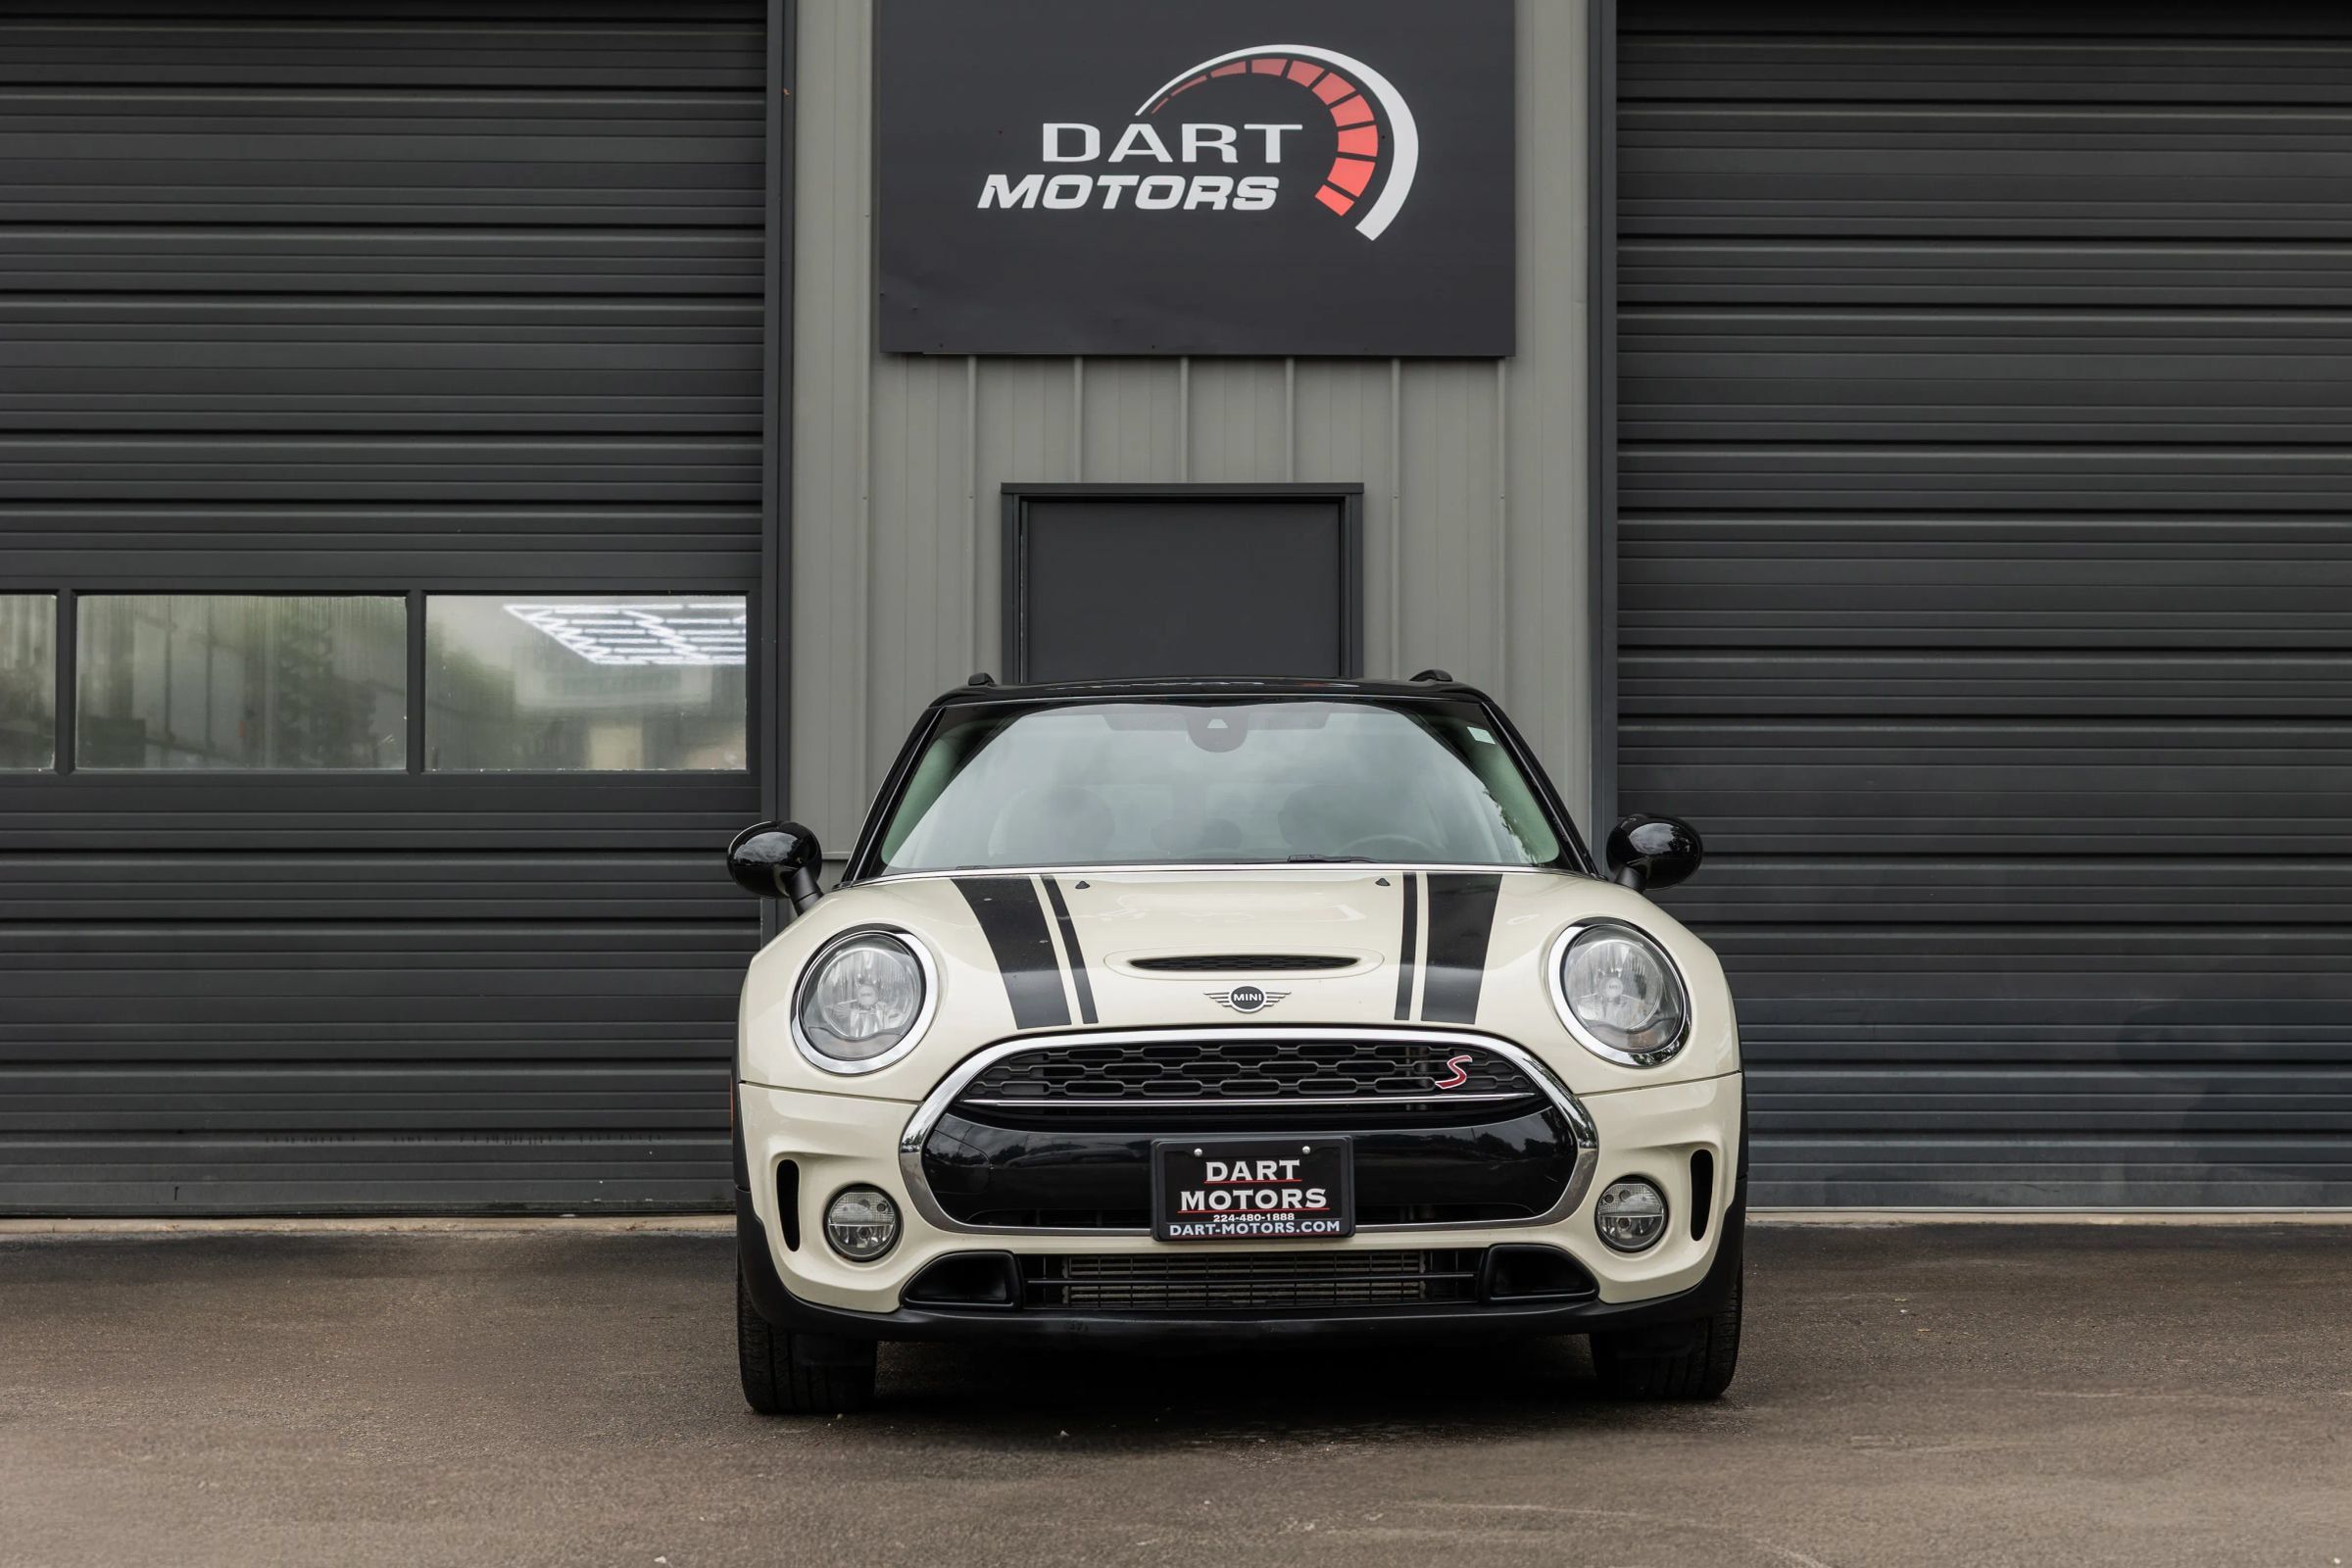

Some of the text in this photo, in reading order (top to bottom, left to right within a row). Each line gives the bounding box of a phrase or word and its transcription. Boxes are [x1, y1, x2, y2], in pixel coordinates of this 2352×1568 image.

[1043, 123, 1302, 163] DART
[977, 174, 1280, 210] MOTORS
[1233, 993, 1262, 1002] MINI
[1435, 1054, 1473, 1090] S
[1205, 1159, 1300, 1182] DART
[1181, 1188, 1327, 1211] MOTORS
[1169, 1221, 1340, 1236] DART-MOTORS.COM
[1213, 1213, 1295, 1222] 224-480-1888
